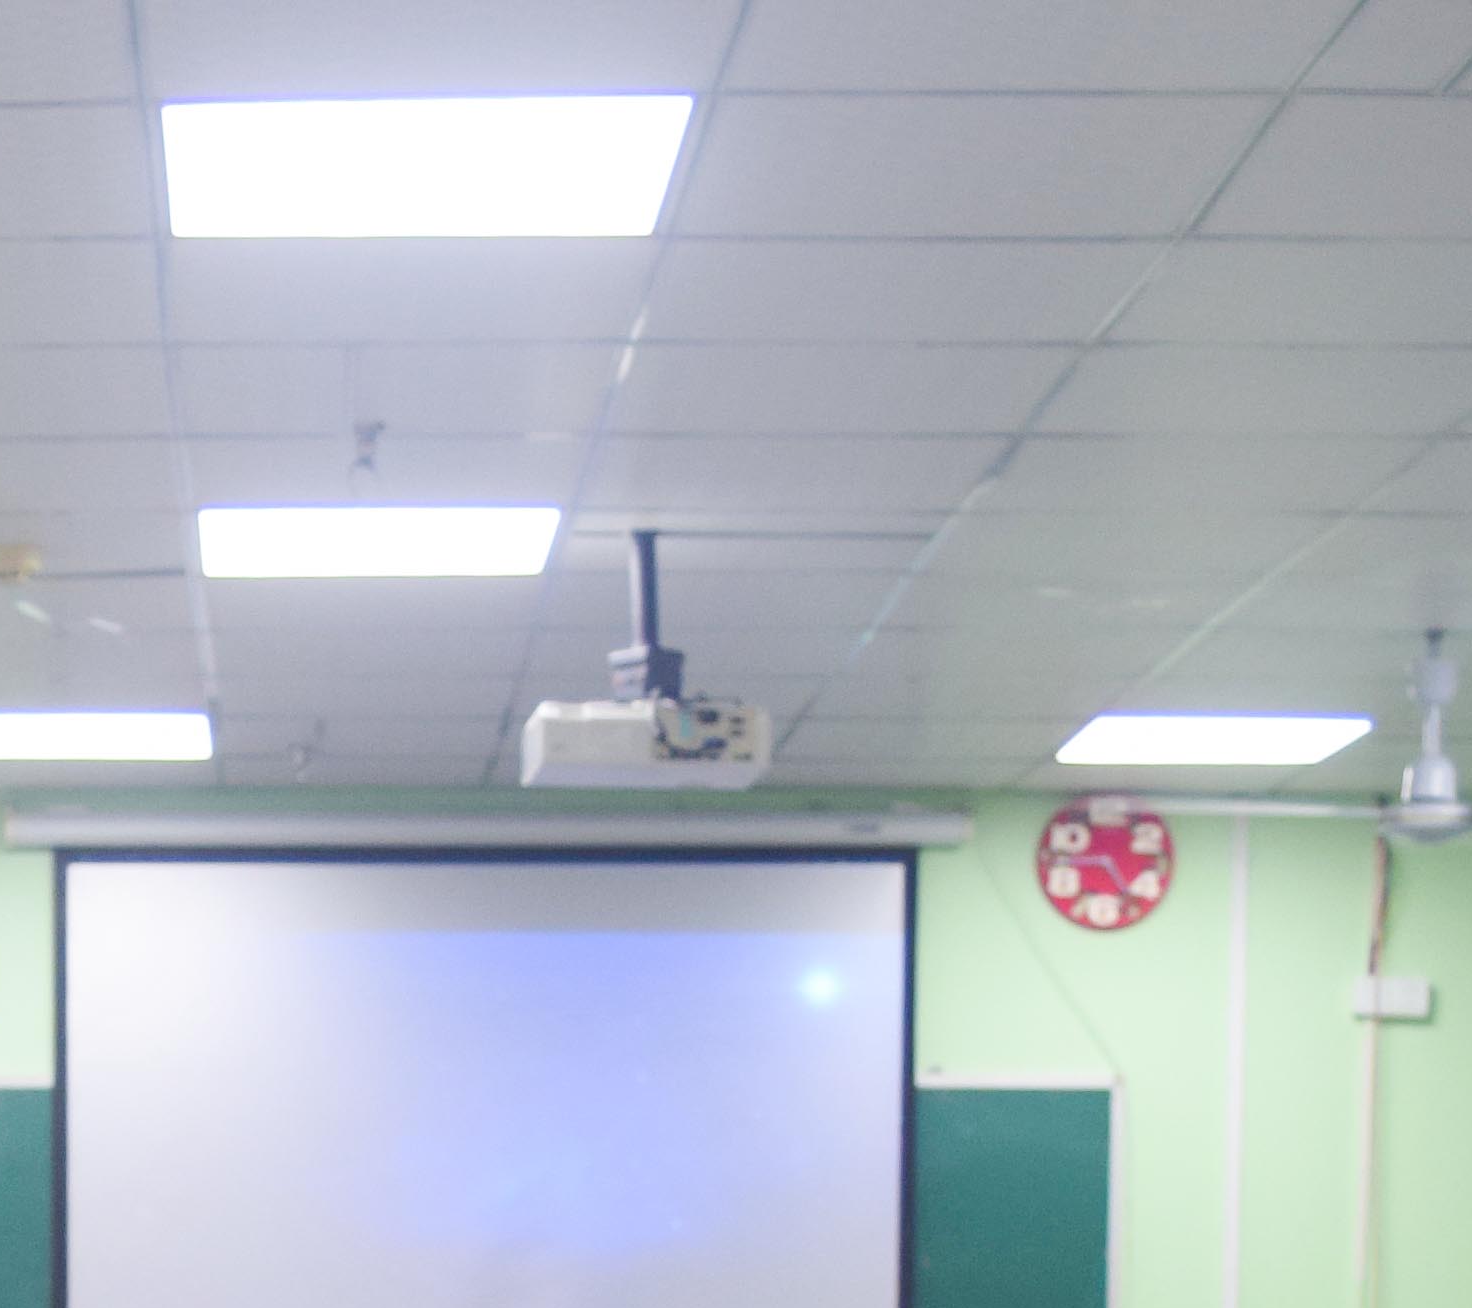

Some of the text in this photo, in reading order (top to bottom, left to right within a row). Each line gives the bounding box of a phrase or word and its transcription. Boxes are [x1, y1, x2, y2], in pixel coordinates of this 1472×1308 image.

[1050, 823, 1091, 853] 10
[1131, 823, 1163, 855] 2
[1048, 866, 1080, 897] 8
[1130, 870, 1160, 900] 4
[1087, 894, 1119, 927] 6
